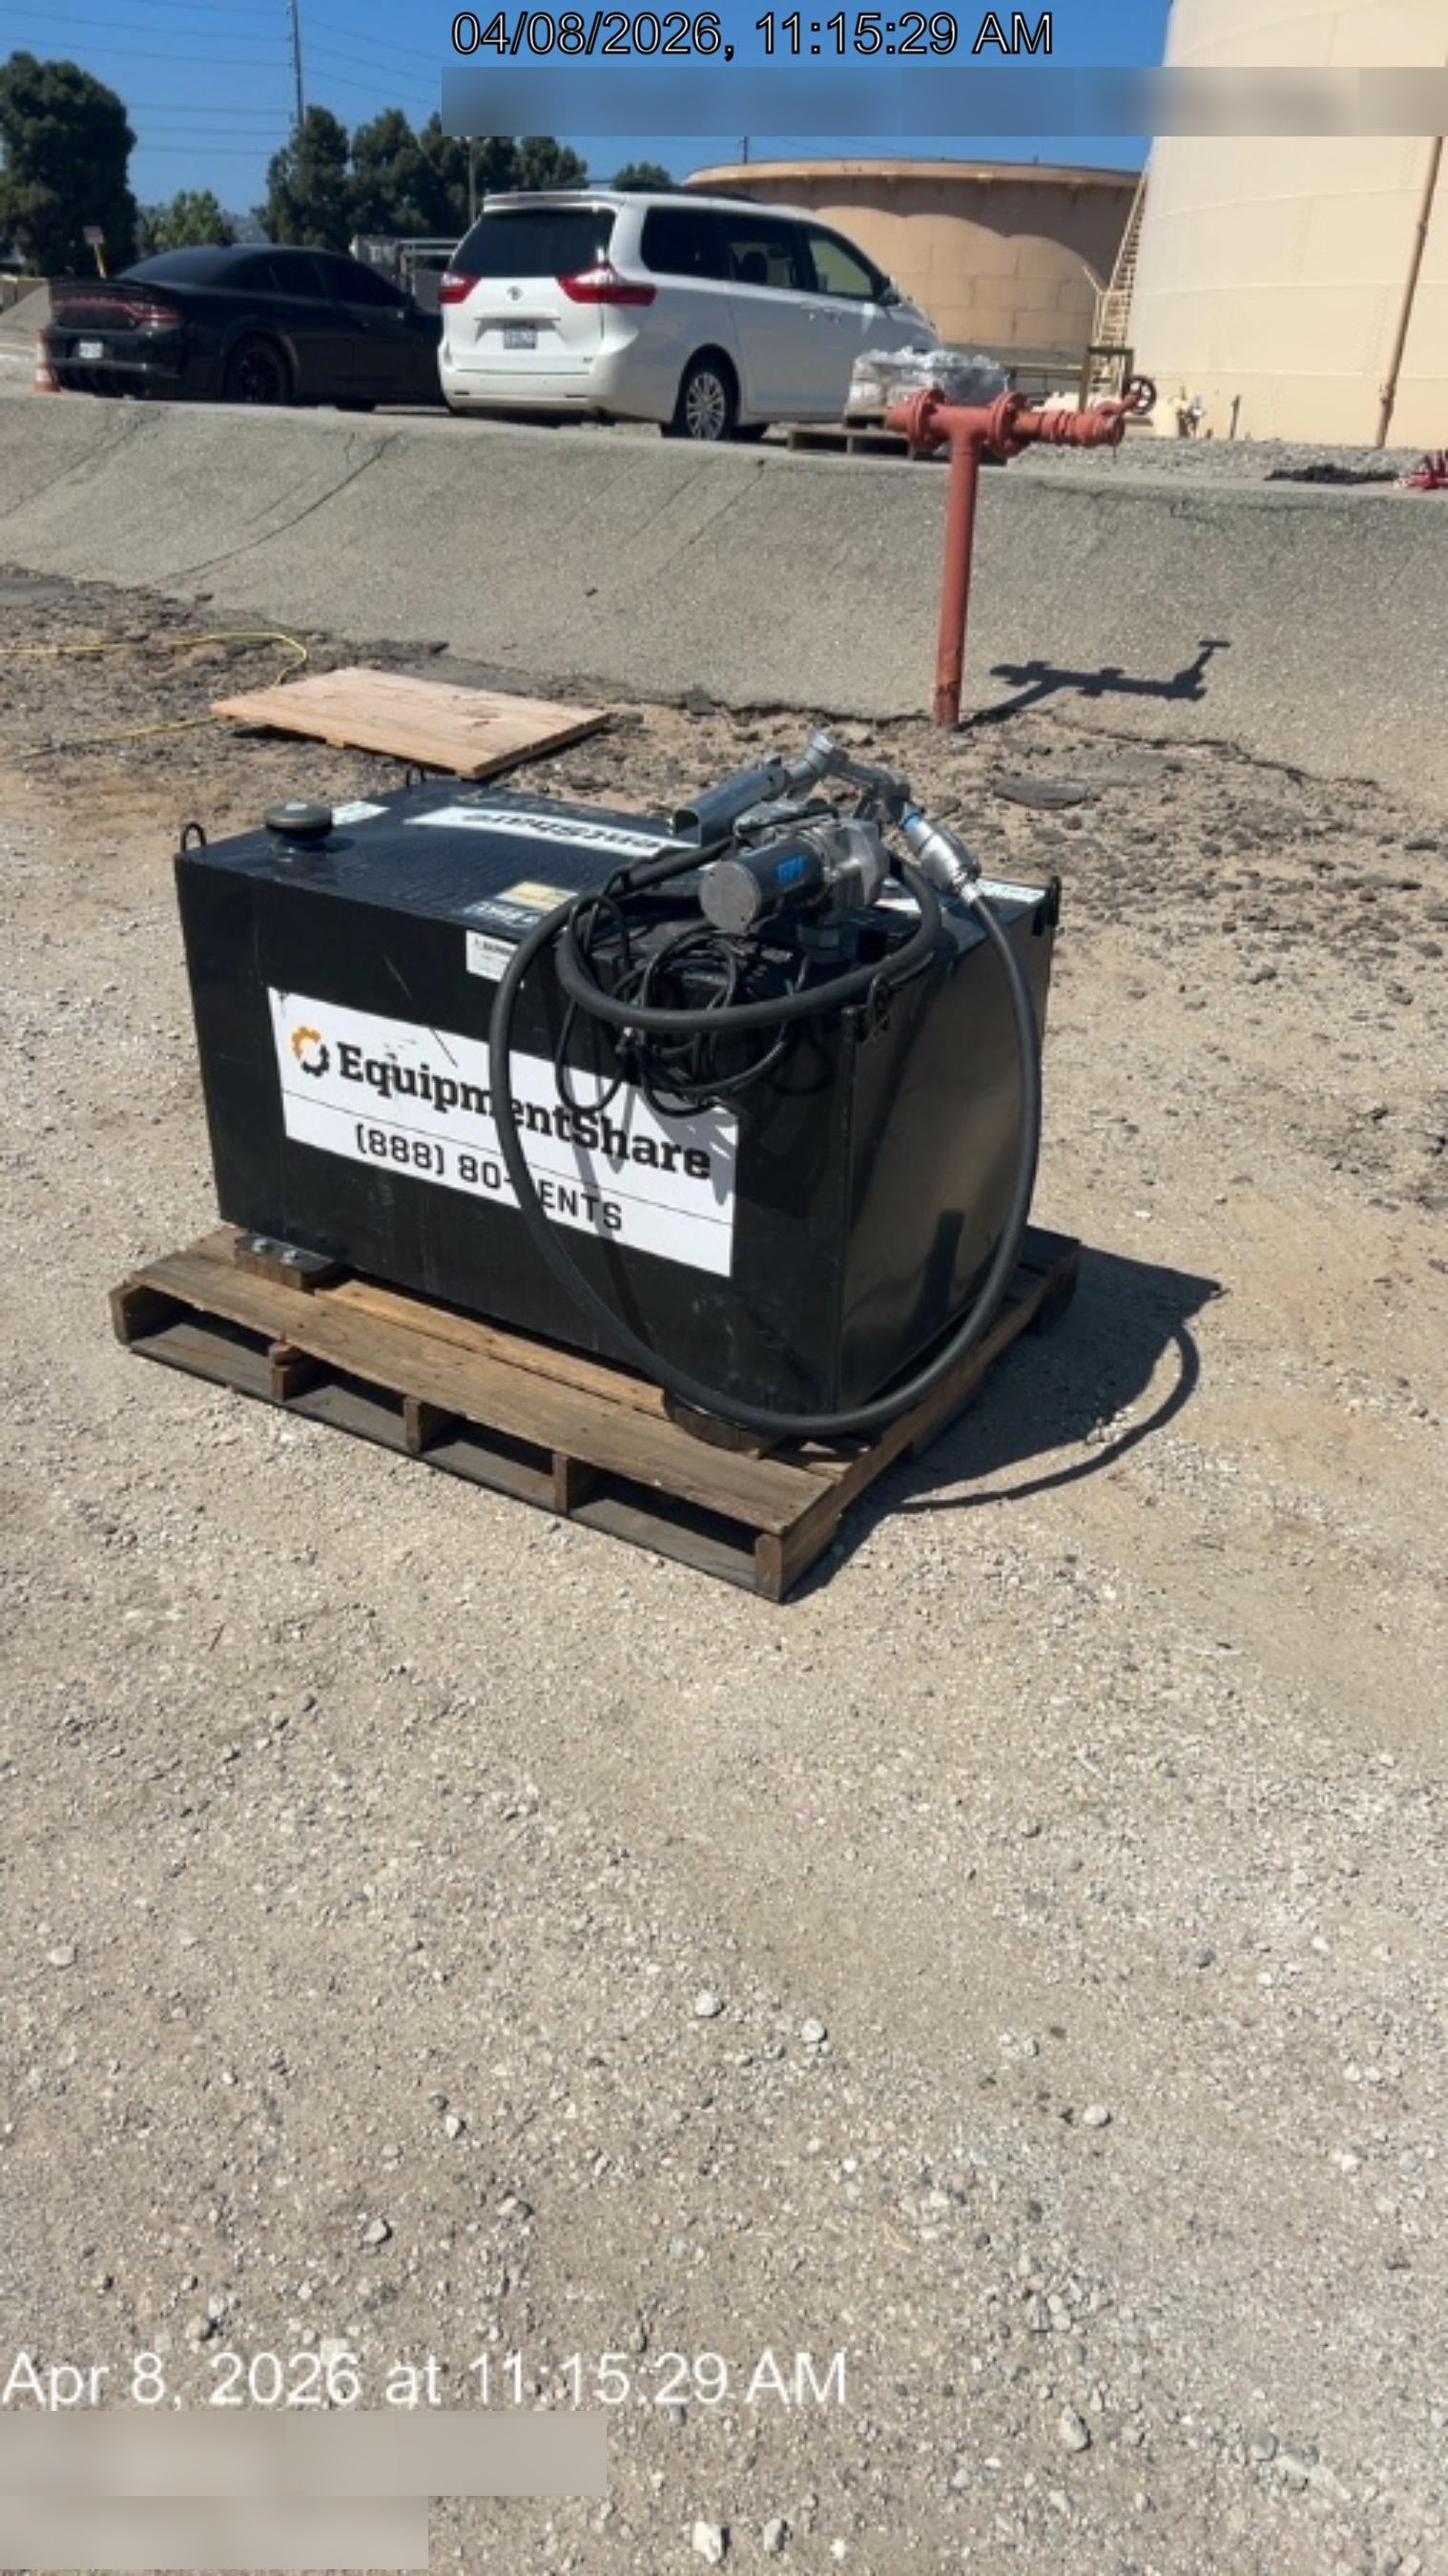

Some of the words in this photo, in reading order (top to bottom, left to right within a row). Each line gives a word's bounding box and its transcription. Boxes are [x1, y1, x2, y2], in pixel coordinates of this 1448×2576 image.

[339, 1042, 711, 1180] EquipmentShare
[355, 1123, 445, 1176] (888)
[459, 1155, 623, 1232] 80-ENTS
